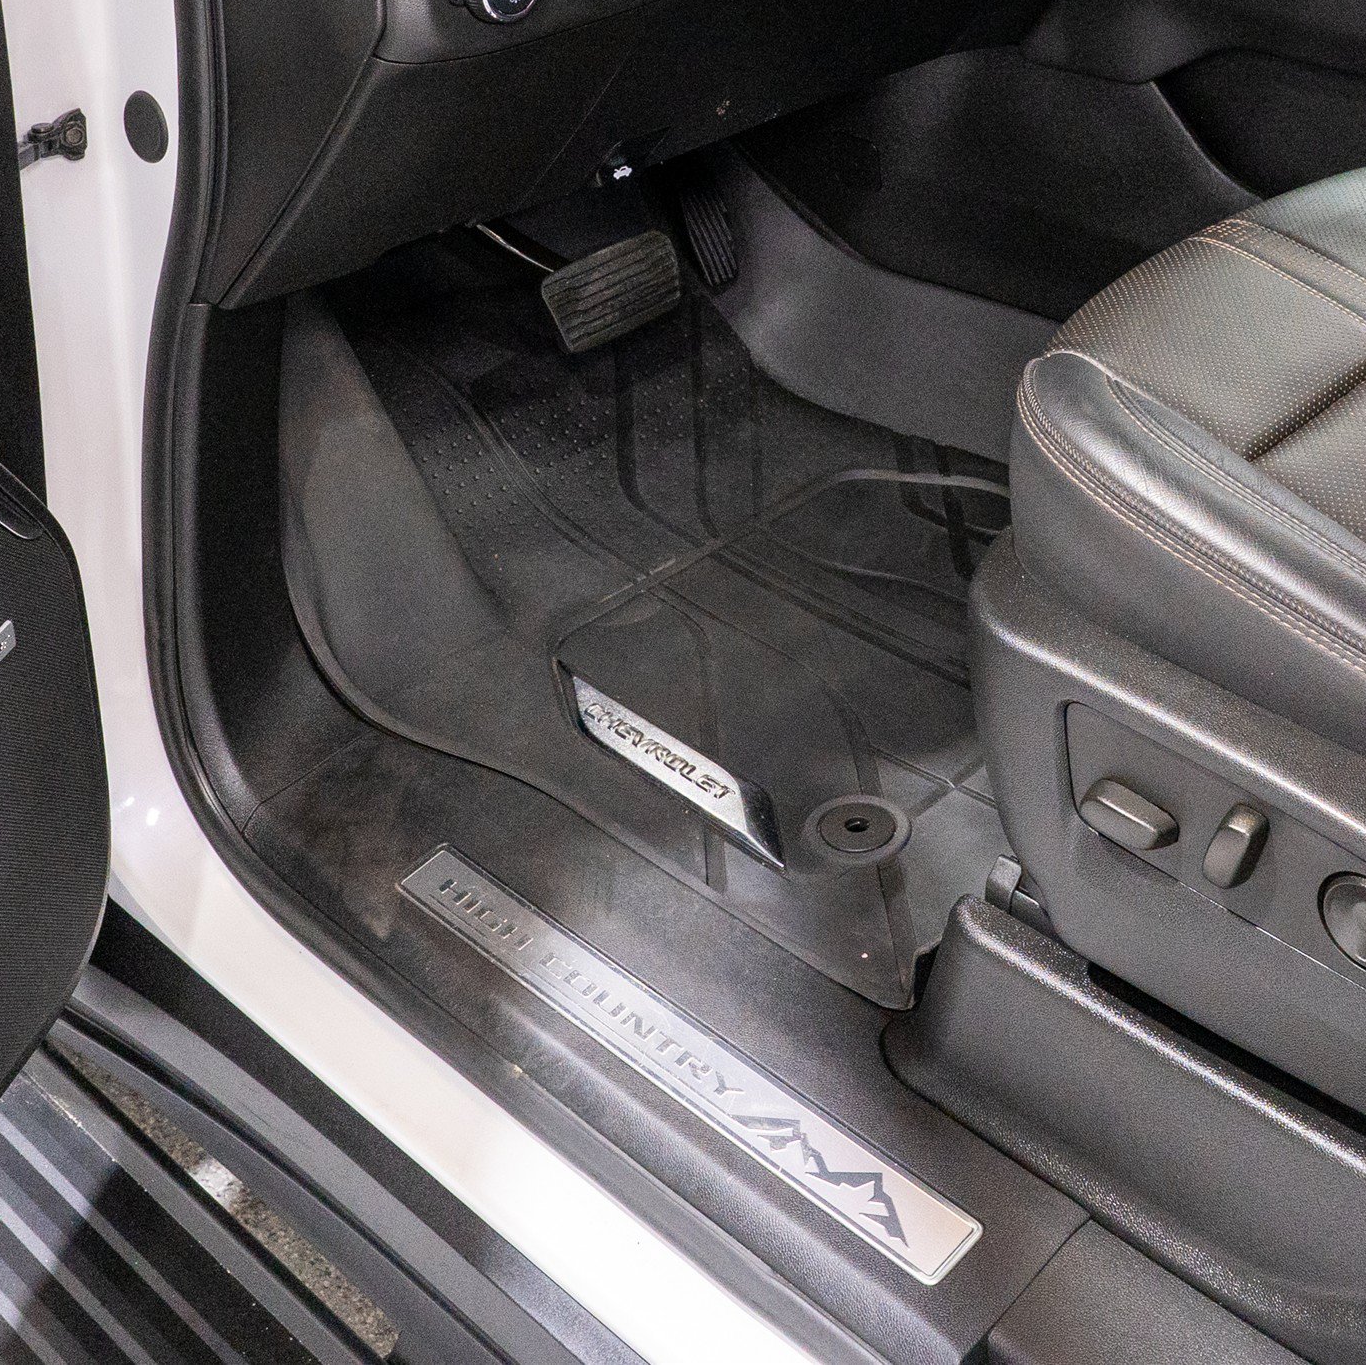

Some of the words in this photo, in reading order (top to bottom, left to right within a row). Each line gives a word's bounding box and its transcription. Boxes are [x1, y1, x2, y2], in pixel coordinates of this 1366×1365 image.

[585, 702, 736, 799] CHEVROLET
[438, 878, 534, 952] HIGH
[537, 950, 745, 1100] COUNTRY
